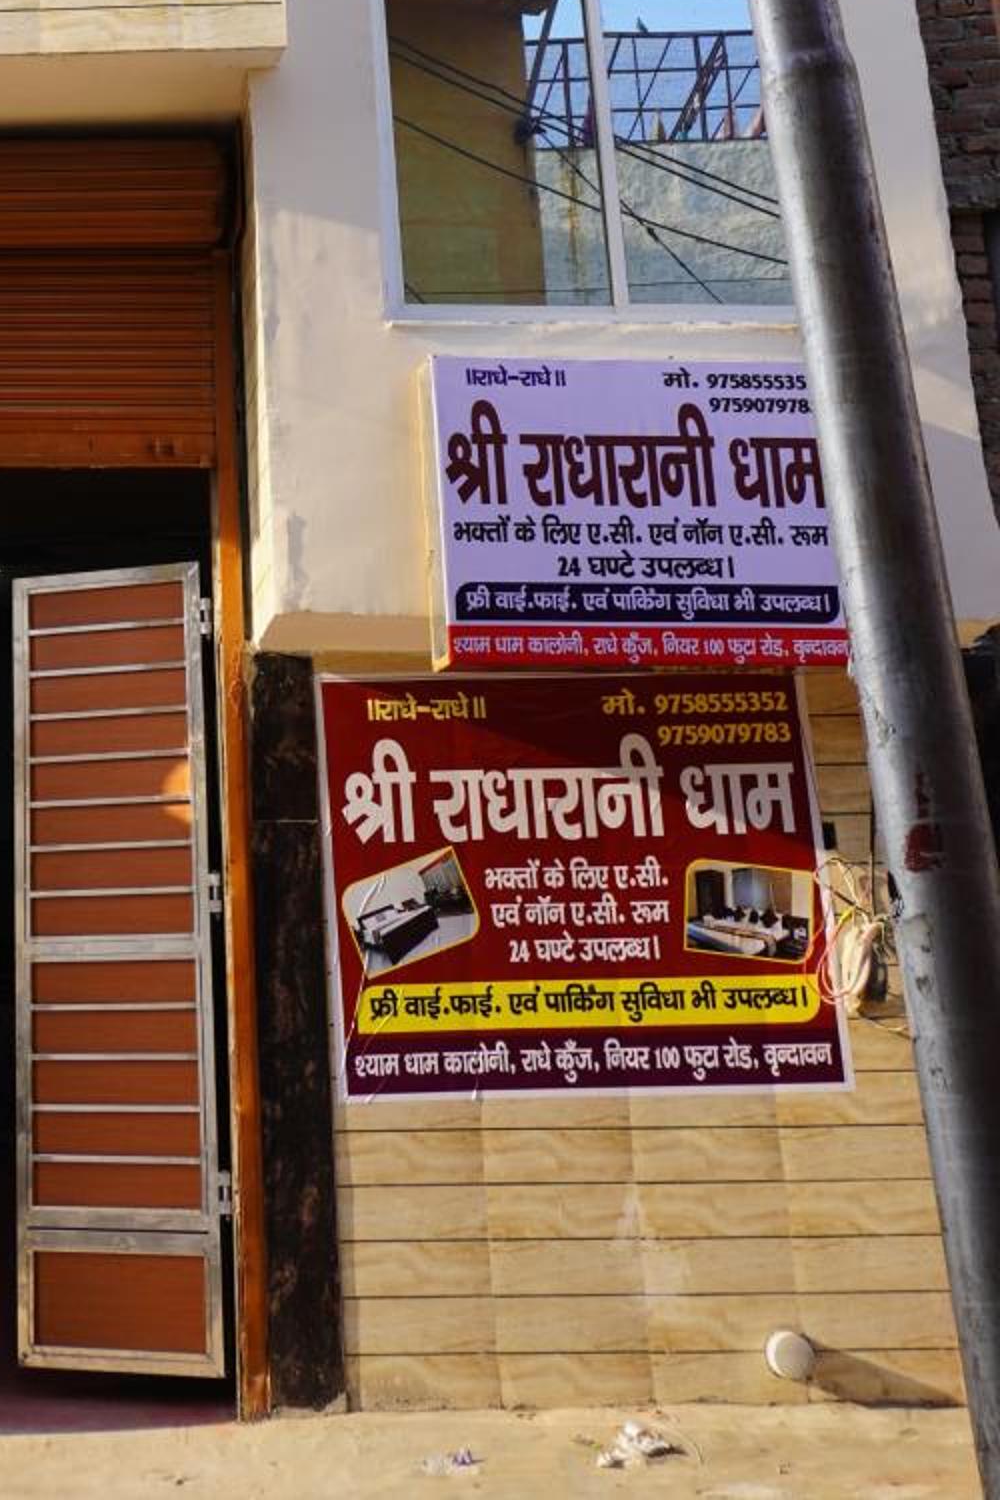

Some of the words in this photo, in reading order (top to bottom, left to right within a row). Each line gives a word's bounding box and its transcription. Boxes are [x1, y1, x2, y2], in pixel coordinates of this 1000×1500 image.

[662, 367, 699, 389] मो.
[706, 373, 808, 391] 975855535
[709, 397, 812, 414] 975907978
[445, 399, 508, 504] श्री
[519, 403, 716, 508] राधारानी
[729, 437, 826, 508] धाम
[453, 515, 511, 543] भक्तों
[514, 516, 536, 543] के
[541, 513, 581, 544] लिए
[587, 514, 642, 545] ए.सी.
[648, 516, 680, 546] एवं
[682, 517, 724, 545] नॉन
[728, 516, 783, 546] ए.सी.
[789, 525, 829, 546] रूम
[558, 556, 582, 577] 24
[587, 549, 636, 577] घण्टे
[465, 584, 491, 612] फ्री
[582, 586, 612, 611] एवं
[675, 587, 730, 620] सुविधा
[733, 587, 755, 612] भी
[661, 631, 699, 656] नियर
[703, 638, 725, 656] 100
[602, 688, 645, 716] मो.
[654, 691, 789, 714] 9758555352
[658, 722, 792, 746] 9759079783
[341, 738, 417, 844] श्री
[429, 733, 665, 843] राधारानी
[679, 762, 796, 836] धाम
[484, 858, 541, 889] भक्तों
[543, 858, 565, 888] के
[569, 856, 609, 889] लिए
[613, 855, 669, 889] ए.सी.
[490, 895, 522, 928] एवं
[524, 895, 566, 925] नॉन
[570, 892, 625, 926] ए.सी.
[630, 900, 670, 924] रूम
[509, 940, 530, 963] 24
[534, 929, 576, 962] घण्टे
[370, 987, 400, 1020] फ्री
[509, 985, 540, 1015] एवं
[621, 981, 685, 1023] सुविधा
[691, 980, 716, 1010] भी
[355, 1053, 400, 1078] श्याम
[404, 1051, 440, 1076] धाम
[520, 1041, 552, 1073] राधे
[603, 1038, 650, 1071] नियर
[654, 1047, 680, 1069] 100
[683, 1045, 720, 1081] फुटा
[762, 1043, 833, 1077] वृन्दावन
